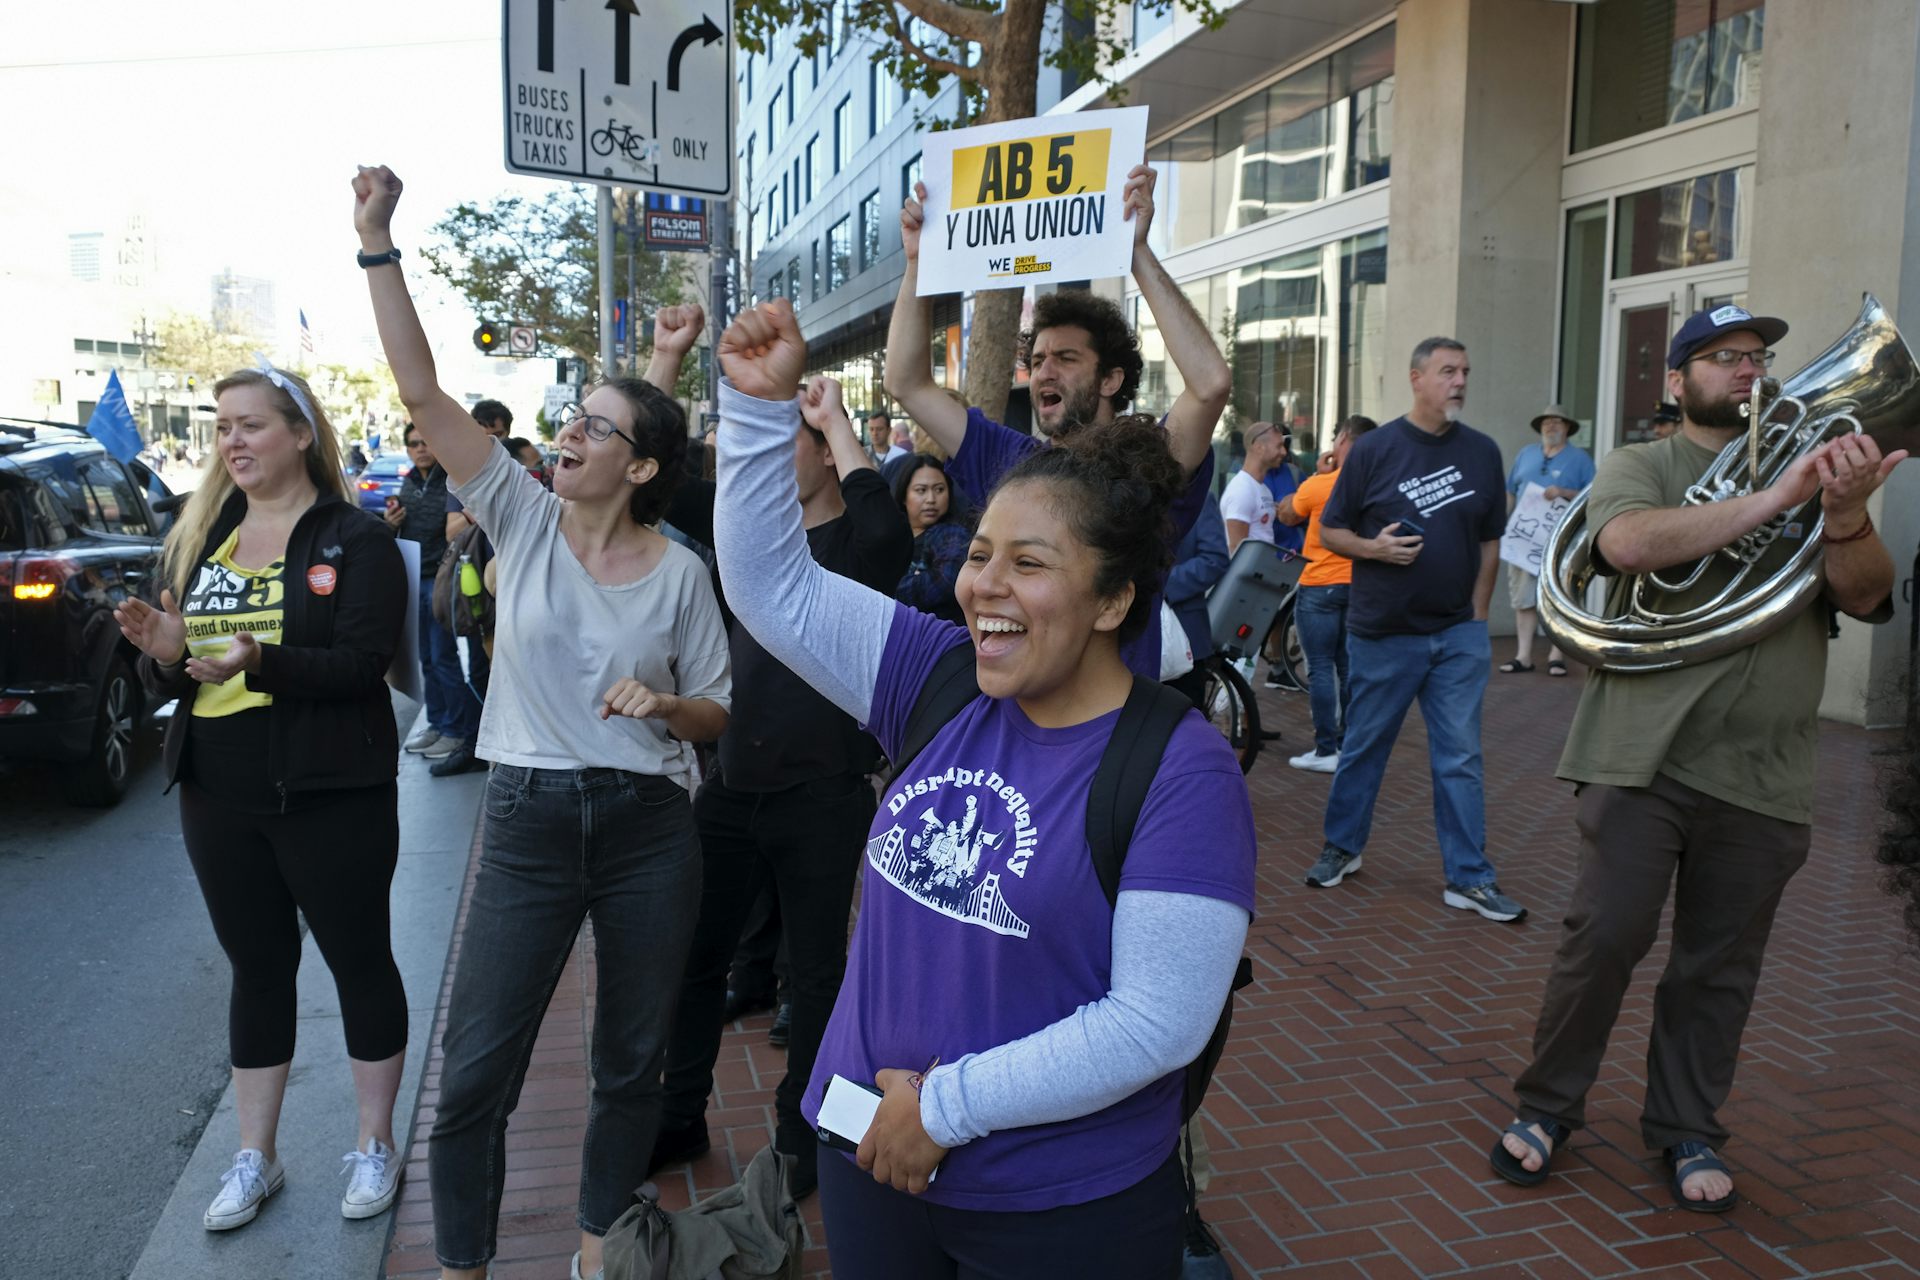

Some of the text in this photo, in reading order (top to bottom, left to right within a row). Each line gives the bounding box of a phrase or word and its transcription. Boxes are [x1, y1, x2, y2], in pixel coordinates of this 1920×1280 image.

[518, 84, 568, 112] BUSES
[514, 112, 574, 141] TRUCKS
[522, 140, 567, 166] TAXIS
[673, 137, 708, 161] ONLY
[976, 135, 1075, 204] AB 5
[651, 216, 700, 231] FOLSOM
[946, 185, 1105, 251] Y UNA UNIÓN
[651, 228, 701, 240] STREET FAIR
[989, 257, 1011, 272] WE
[1014, 262, 1051, 274] PROGRESS
[1015, 255, 1036, 264] DRIVE
[1398, 477, 1421, 493] GIG
[1405, 470, 1463, 500] WORKERS
[1414, 485, 1455, 508] RISING
[1508, 513, 1540, 543] YES
[190, 564, 247, 595] YES
[186, 600, 202, 612] on
[205, 596, 239, 610] AB
